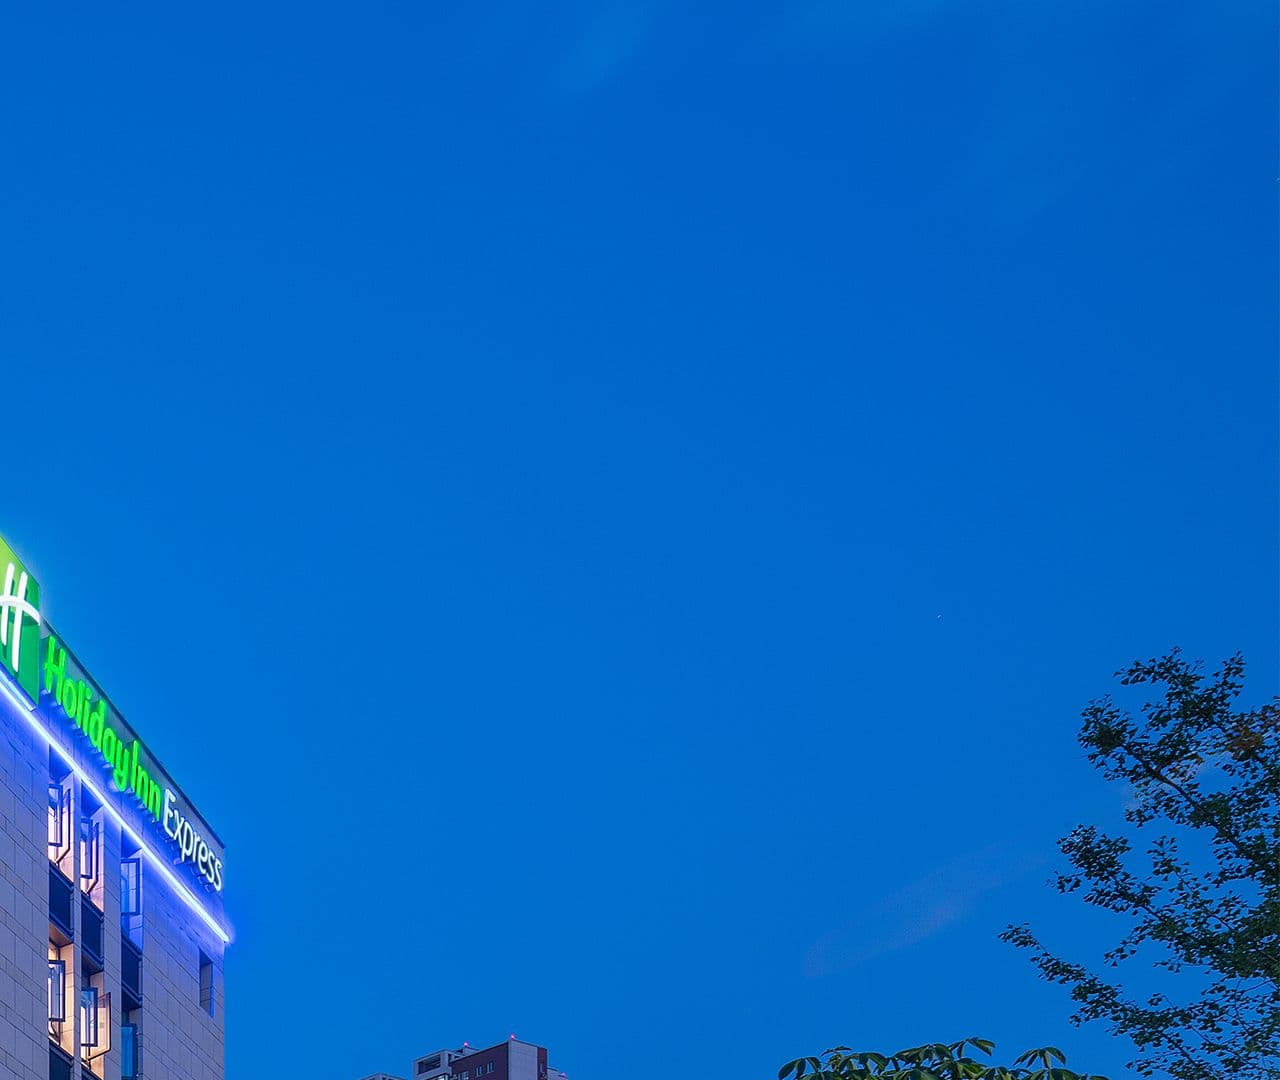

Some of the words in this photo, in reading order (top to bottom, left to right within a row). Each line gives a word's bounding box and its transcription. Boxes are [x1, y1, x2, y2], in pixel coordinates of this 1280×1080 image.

[44, 634, 129, 792] Holiday
[130, 739, 162, 822] Inn
[162, 788, 223, 892] Express
